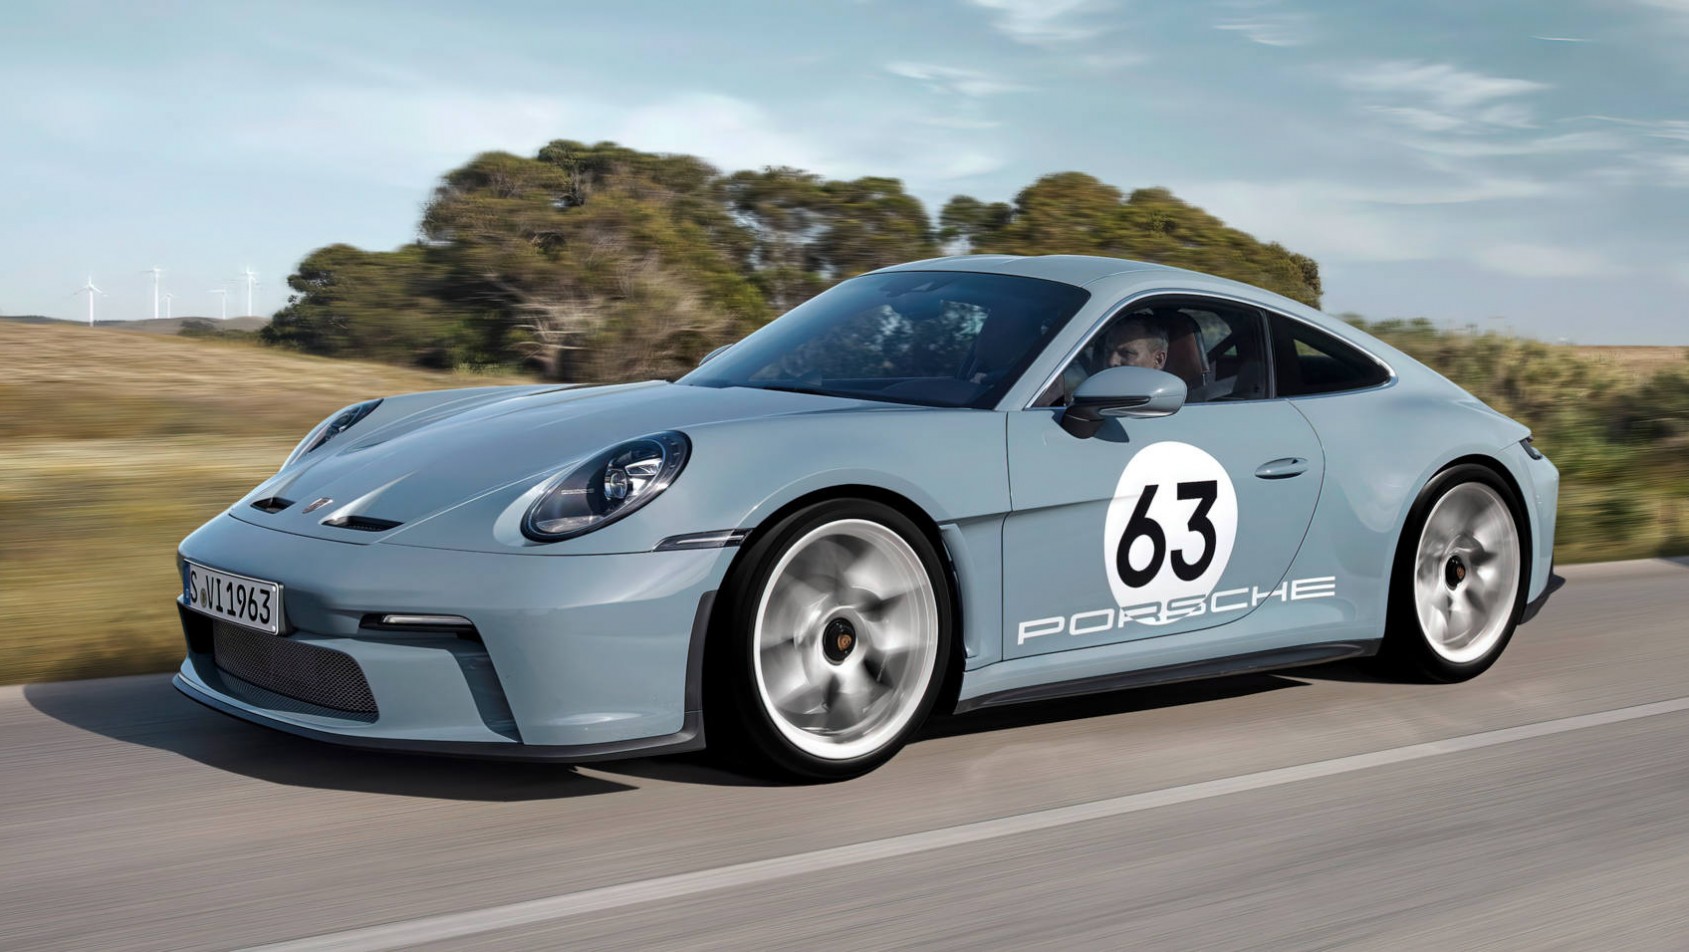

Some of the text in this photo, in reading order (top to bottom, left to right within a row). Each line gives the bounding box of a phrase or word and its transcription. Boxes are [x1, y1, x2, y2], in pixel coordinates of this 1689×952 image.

[1116, 480, 1217, 588] 63
[191, 570, 198, 603] S
[1017, 576, 1336, 645] PORSCHE
